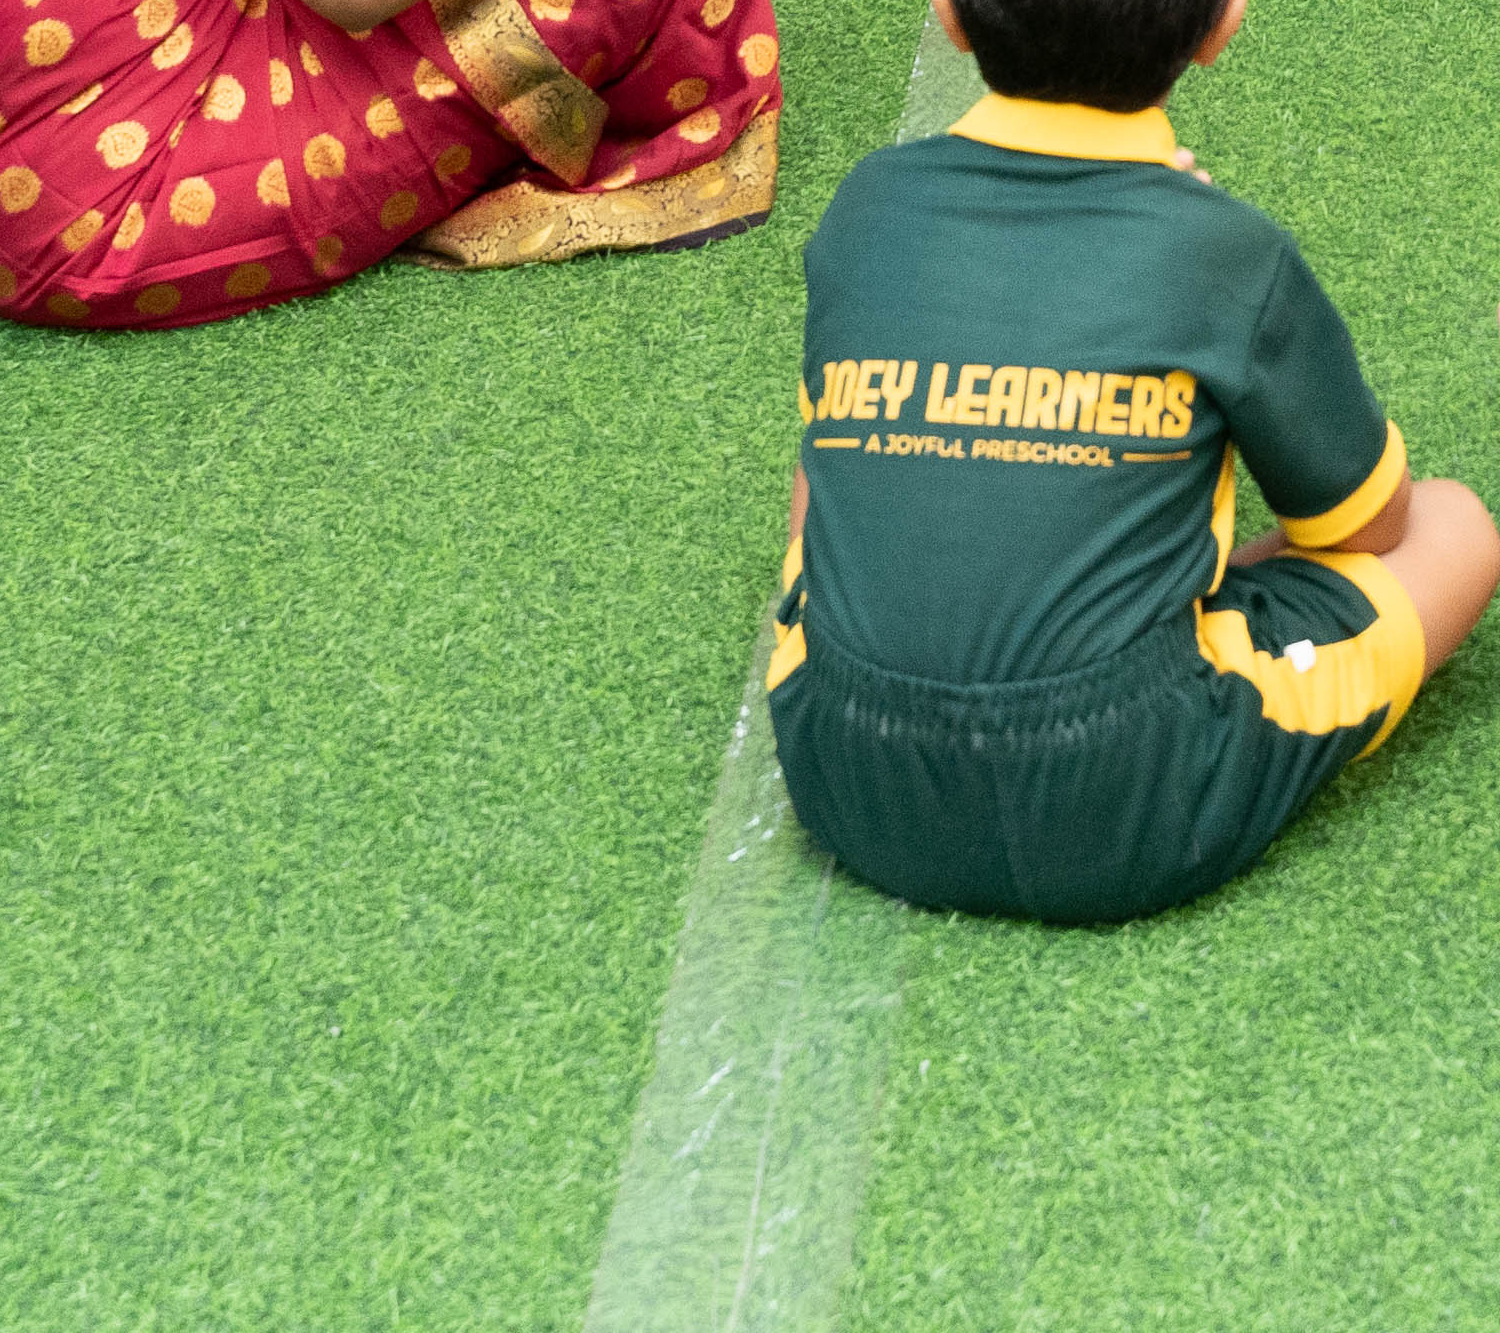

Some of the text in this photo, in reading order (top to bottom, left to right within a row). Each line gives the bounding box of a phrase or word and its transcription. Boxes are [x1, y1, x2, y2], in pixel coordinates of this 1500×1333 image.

[816, 358, 1196, 439] JOEY LEARNERS
[864, 433, 1116, 468] A JOYFUL PRESCHOOL
